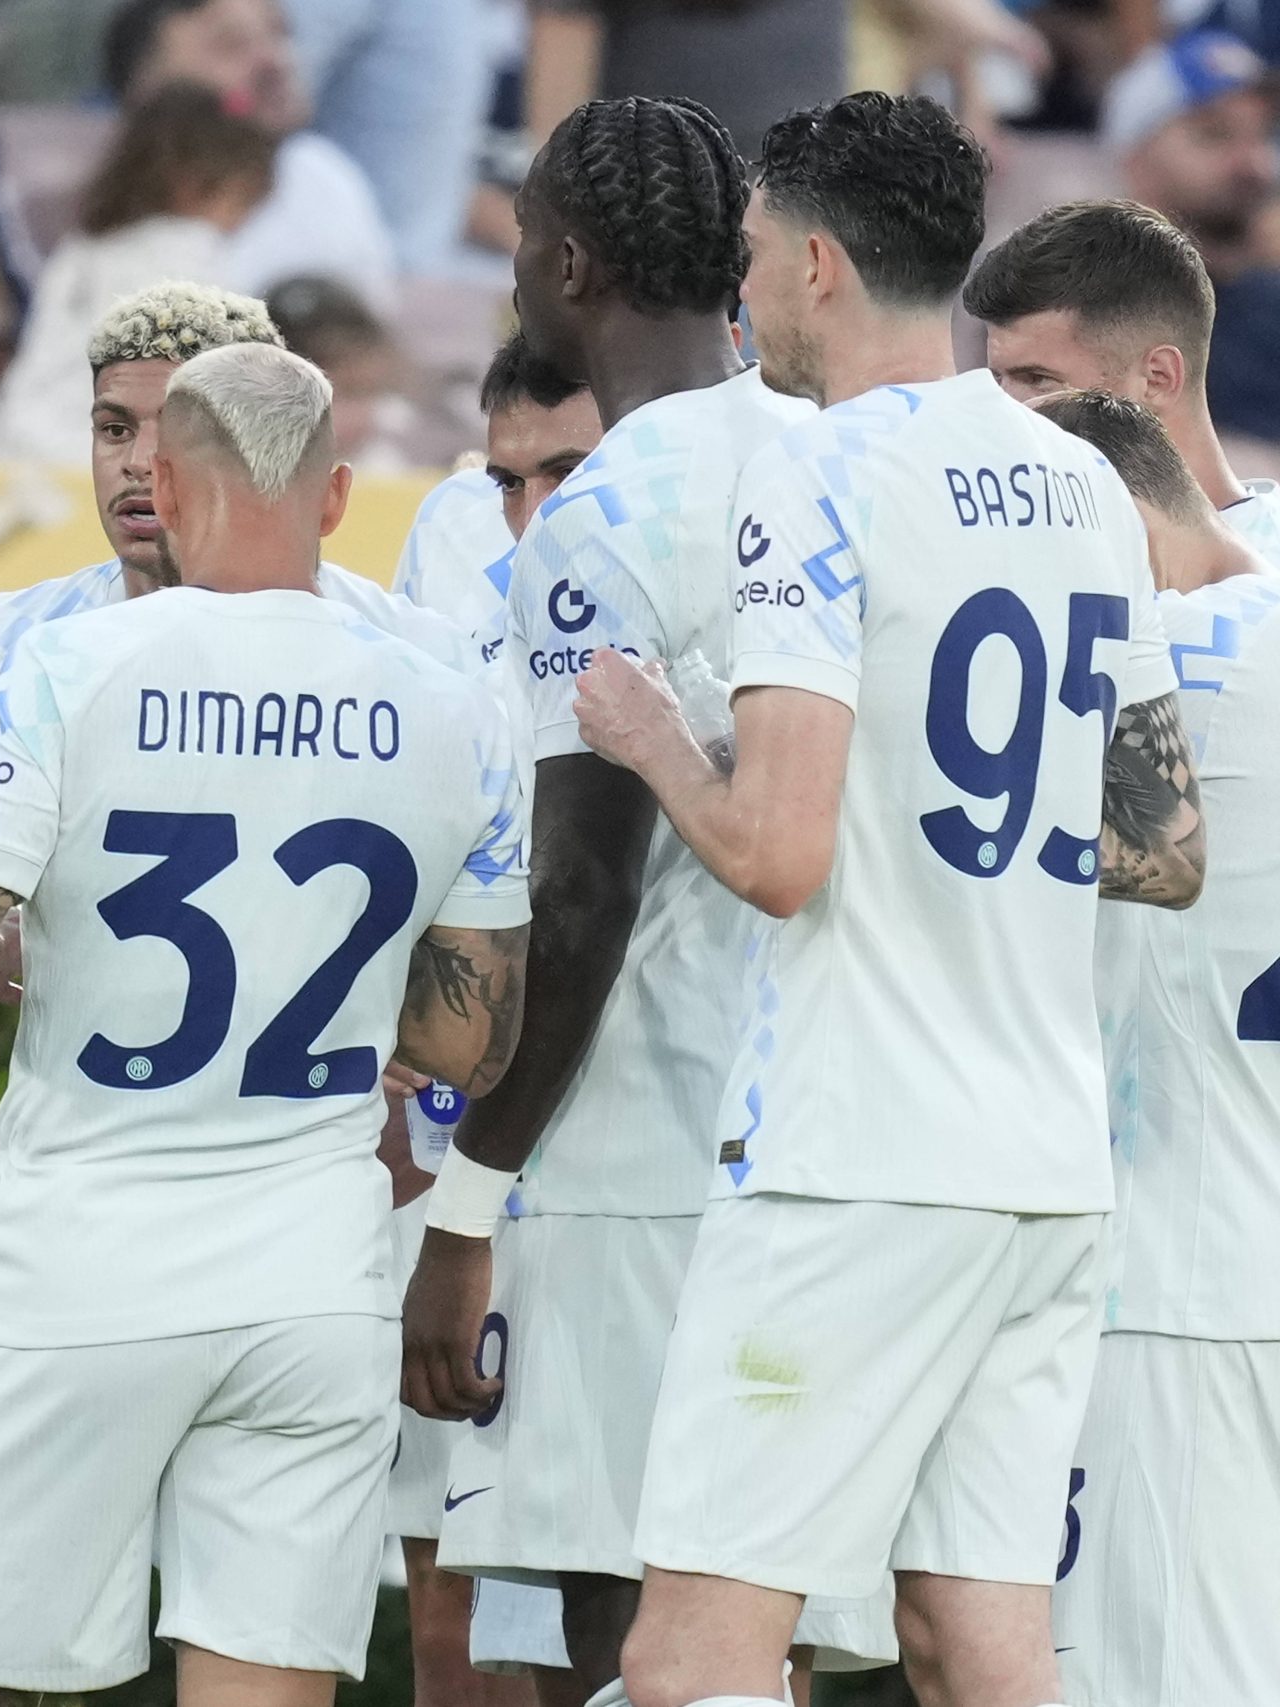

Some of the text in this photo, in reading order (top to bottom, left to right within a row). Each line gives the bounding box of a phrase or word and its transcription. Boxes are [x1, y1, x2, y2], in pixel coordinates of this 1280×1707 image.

[943, 464, 1102, 530] BASTONI
[138, 688, 401, 762] DIMARCO
[919, 586, 1130, 886] 95
[77, 808, 419, 1099] 32
